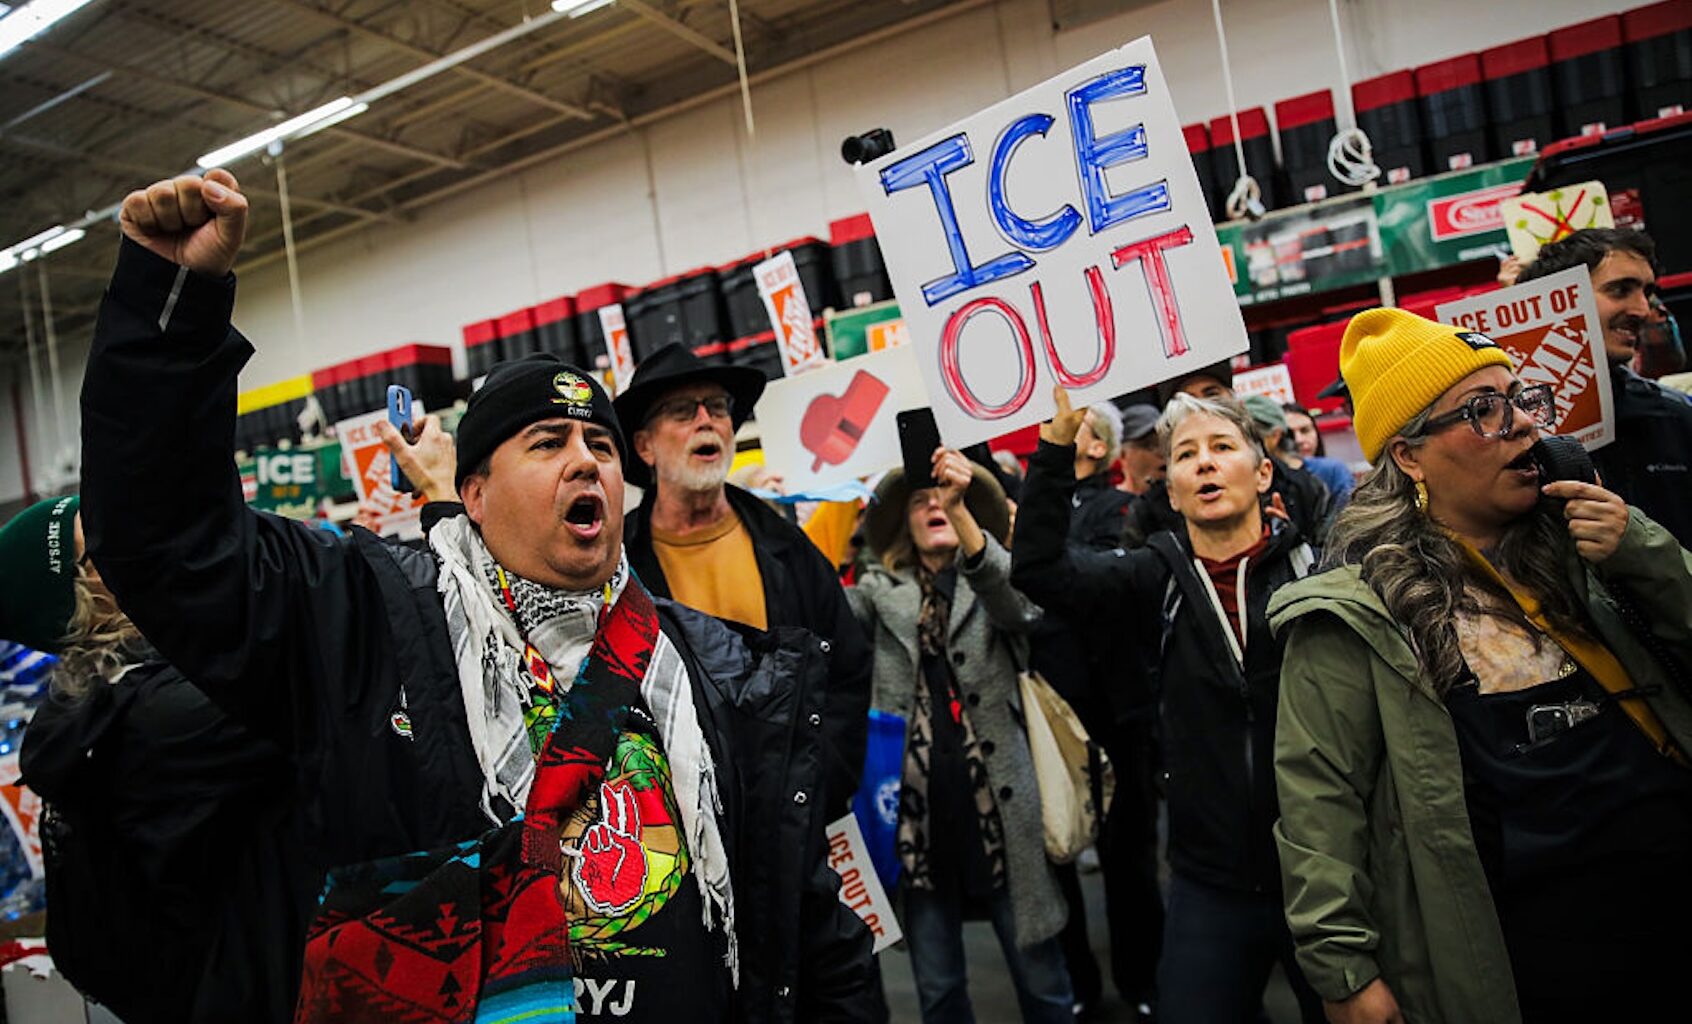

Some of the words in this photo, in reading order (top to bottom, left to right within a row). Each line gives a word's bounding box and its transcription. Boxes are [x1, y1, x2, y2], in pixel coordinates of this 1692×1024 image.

[879, 64, 1172, 307] ICE
[938, 224, 1194, 420] OUT
[1495, 295, 1542, 328] OUT
[1550, 284, 1578, 314] OF
[257, 454, 315, 485] ICE
[828, 831, 854, 869] ICE
[841, 867, 873, 912] OUT
